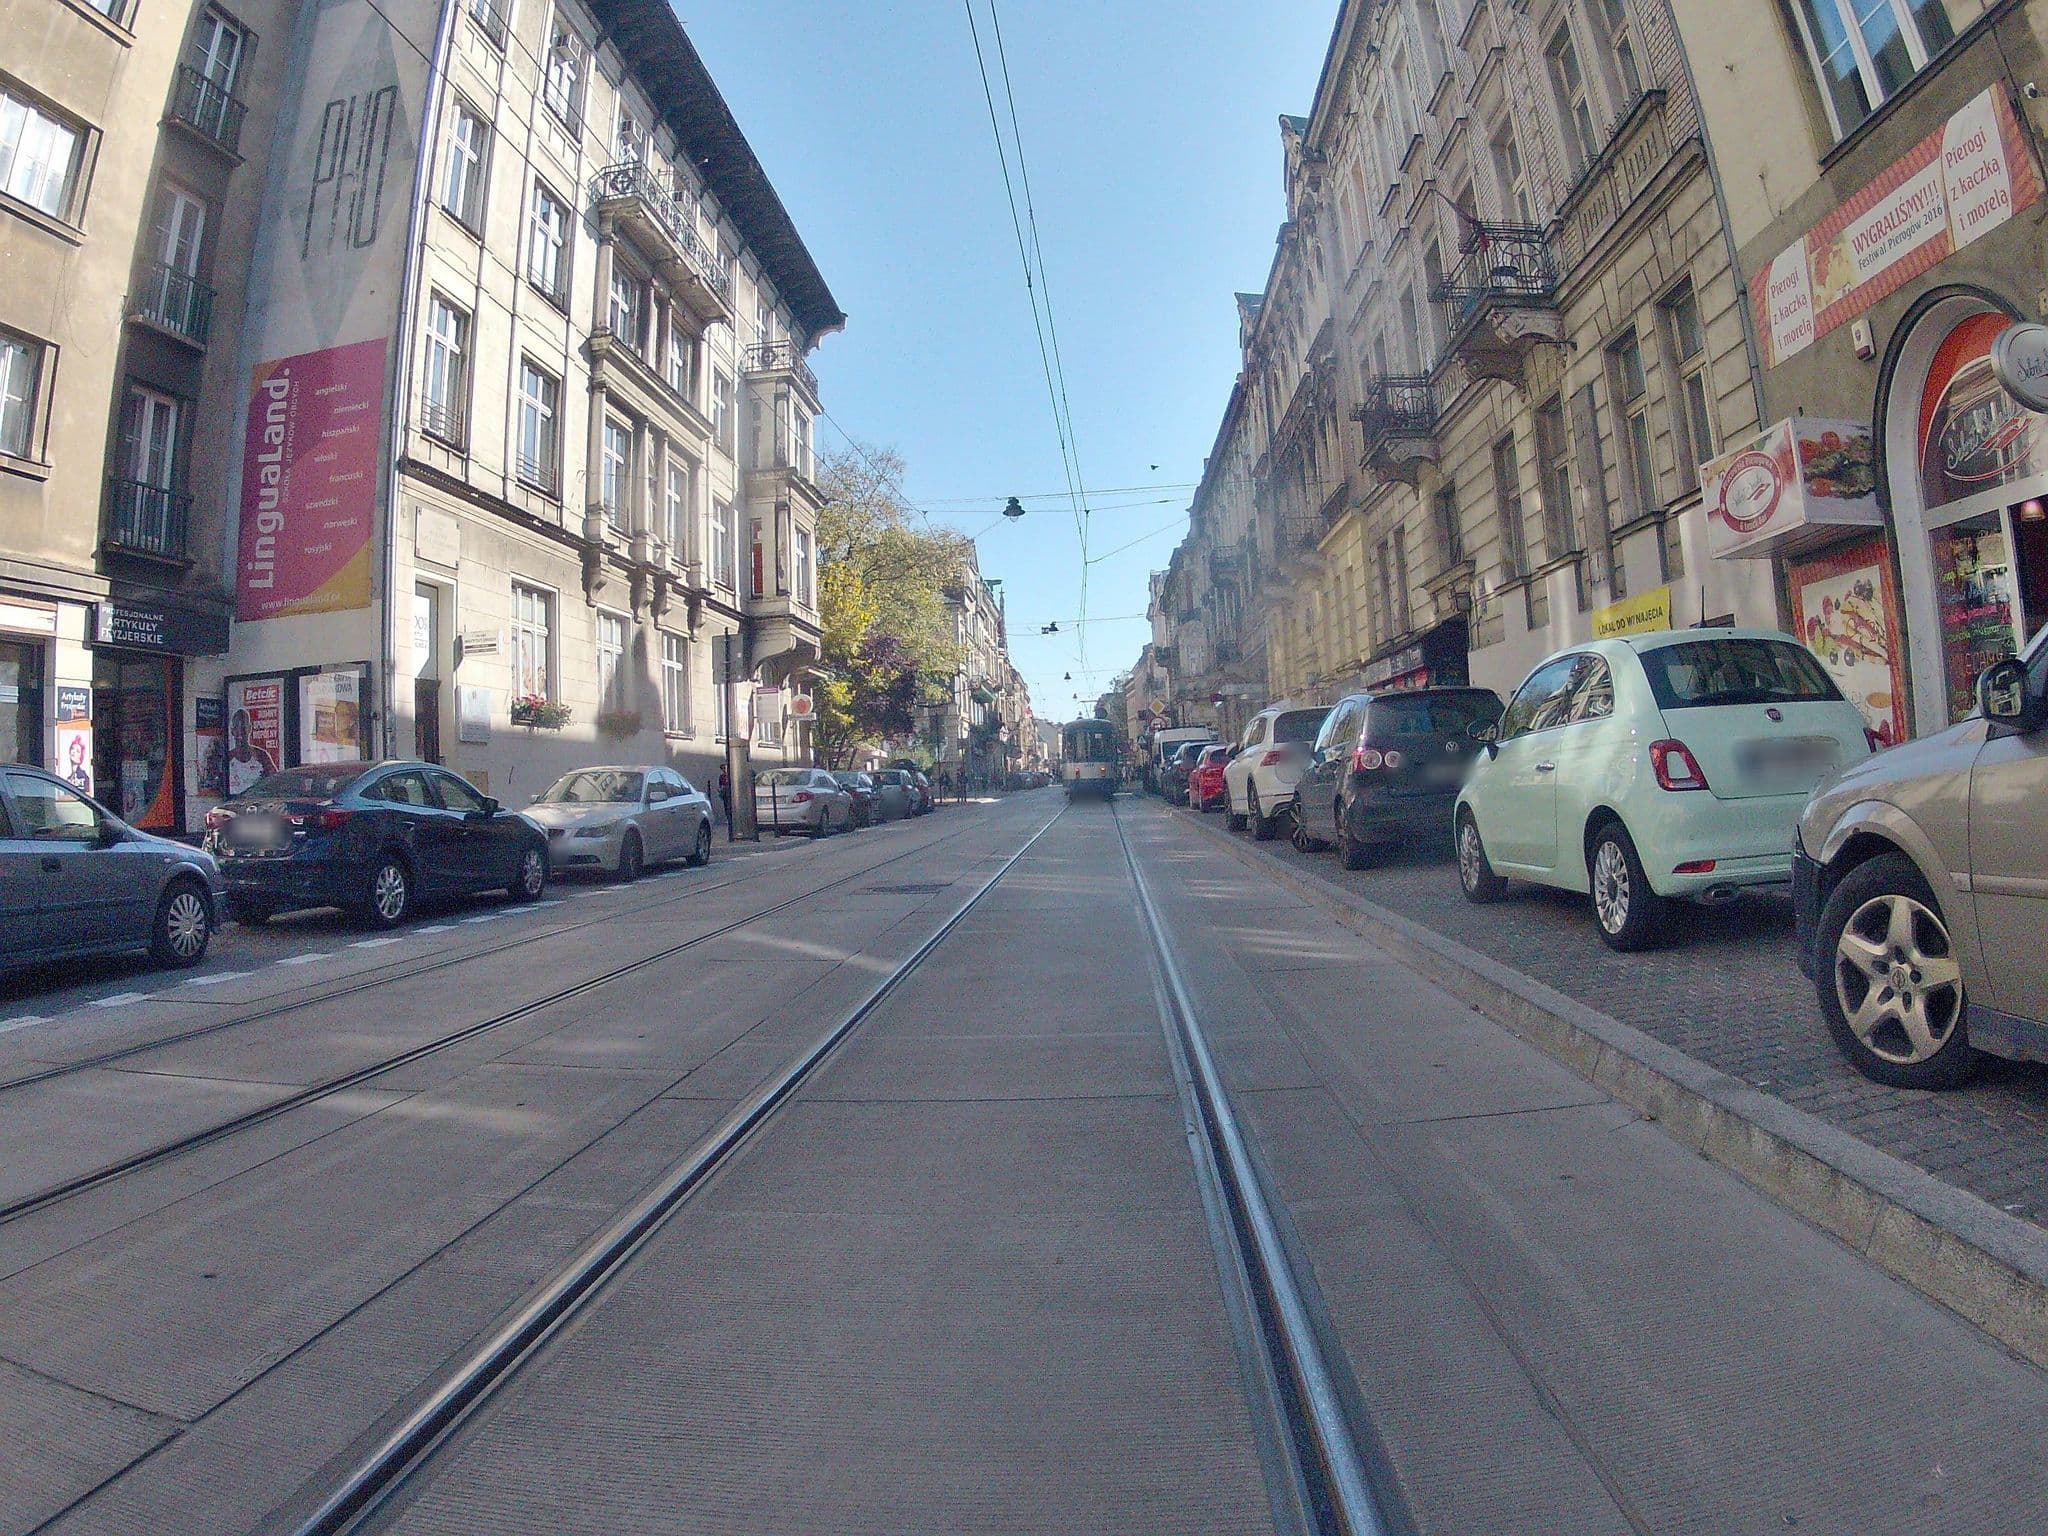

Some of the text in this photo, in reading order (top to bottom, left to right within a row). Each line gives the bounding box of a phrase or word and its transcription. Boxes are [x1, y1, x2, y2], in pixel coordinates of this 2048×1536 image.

[1945, 126, 1987, 168] Pierogi
[1951, 158, 2001, 201] z kaczką
[1852, 179, 1940, 256] WYGRALIŚMY!!!
[1959, 189, 2009, 230] i morelą
[1858, 244, 1887, 270] Festiwal
[1923, 204, 1944, 225] 2016
[1770, 267, 1800, 299] Pierogi
[1774, 294, 1808, 325] z kaczką
[1778, 318, 1813, 350] i morelą
[314, 382, 347, 397] angielski
[329, 471, 364, 484] francuski
[304, 542, 332, 554] rosyjski
[101, 606, 165, 622] PROFESJONALNE
[106, 617, 158, 632] ARTYKUŁY
[1598, 620, 1616, 636] LOKAL
[1616, 618, 1626, 631] DO
[100, 628, 164, 644] FRYZJERSKIE
